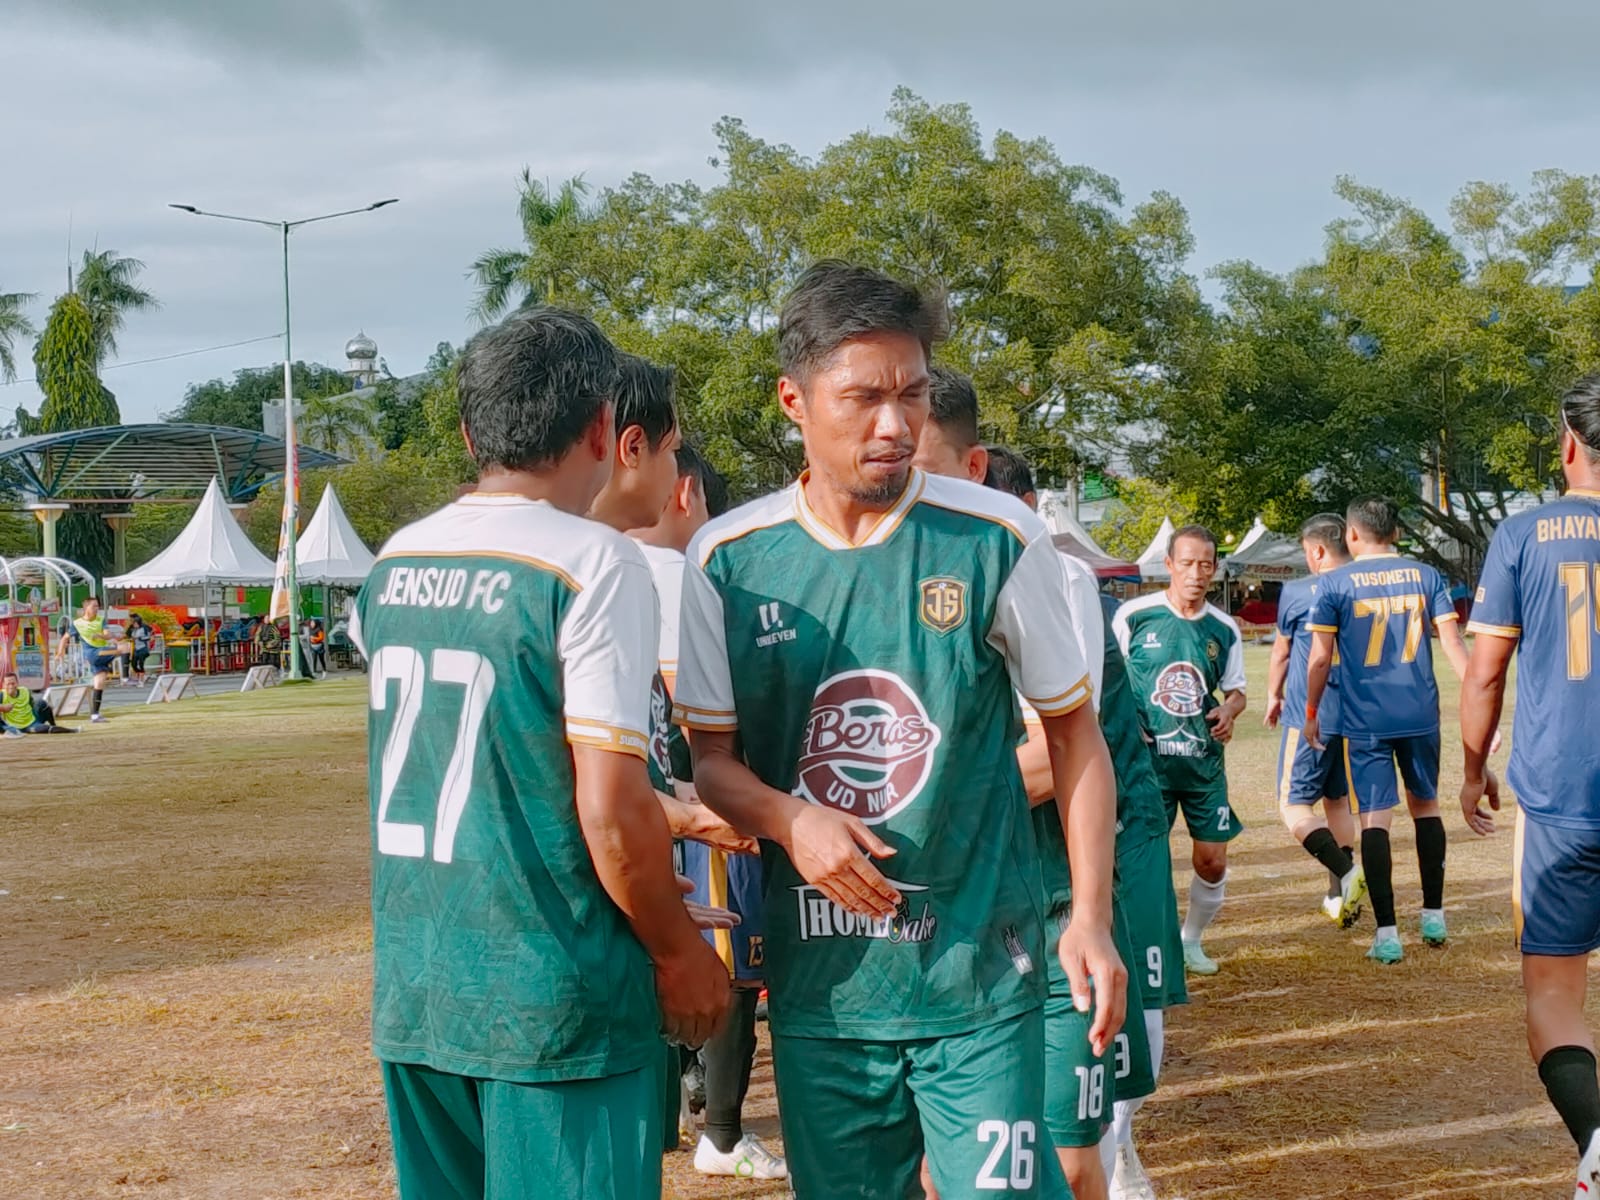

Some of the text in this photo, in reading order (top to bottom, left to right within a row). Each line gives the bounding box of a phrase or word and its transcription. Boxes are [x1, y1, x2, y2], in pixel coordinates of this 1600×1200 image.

[1536, 515, 1600, 543] BHAYA
[377, 567, 512, 614] JENSUD FC
[1353, 594, 1426, 668] 77
[1558, 562, 1600, 681] 1
[370, 646, 496, 864] 27
[808, 705, 933, 759] Beras
[826, 780, 856, 810] UD
[1146, 945, 1163, 988] 9
[1075, 1064, 1105, 1121] 18
[975, 1120, 1036, 1190] 26
